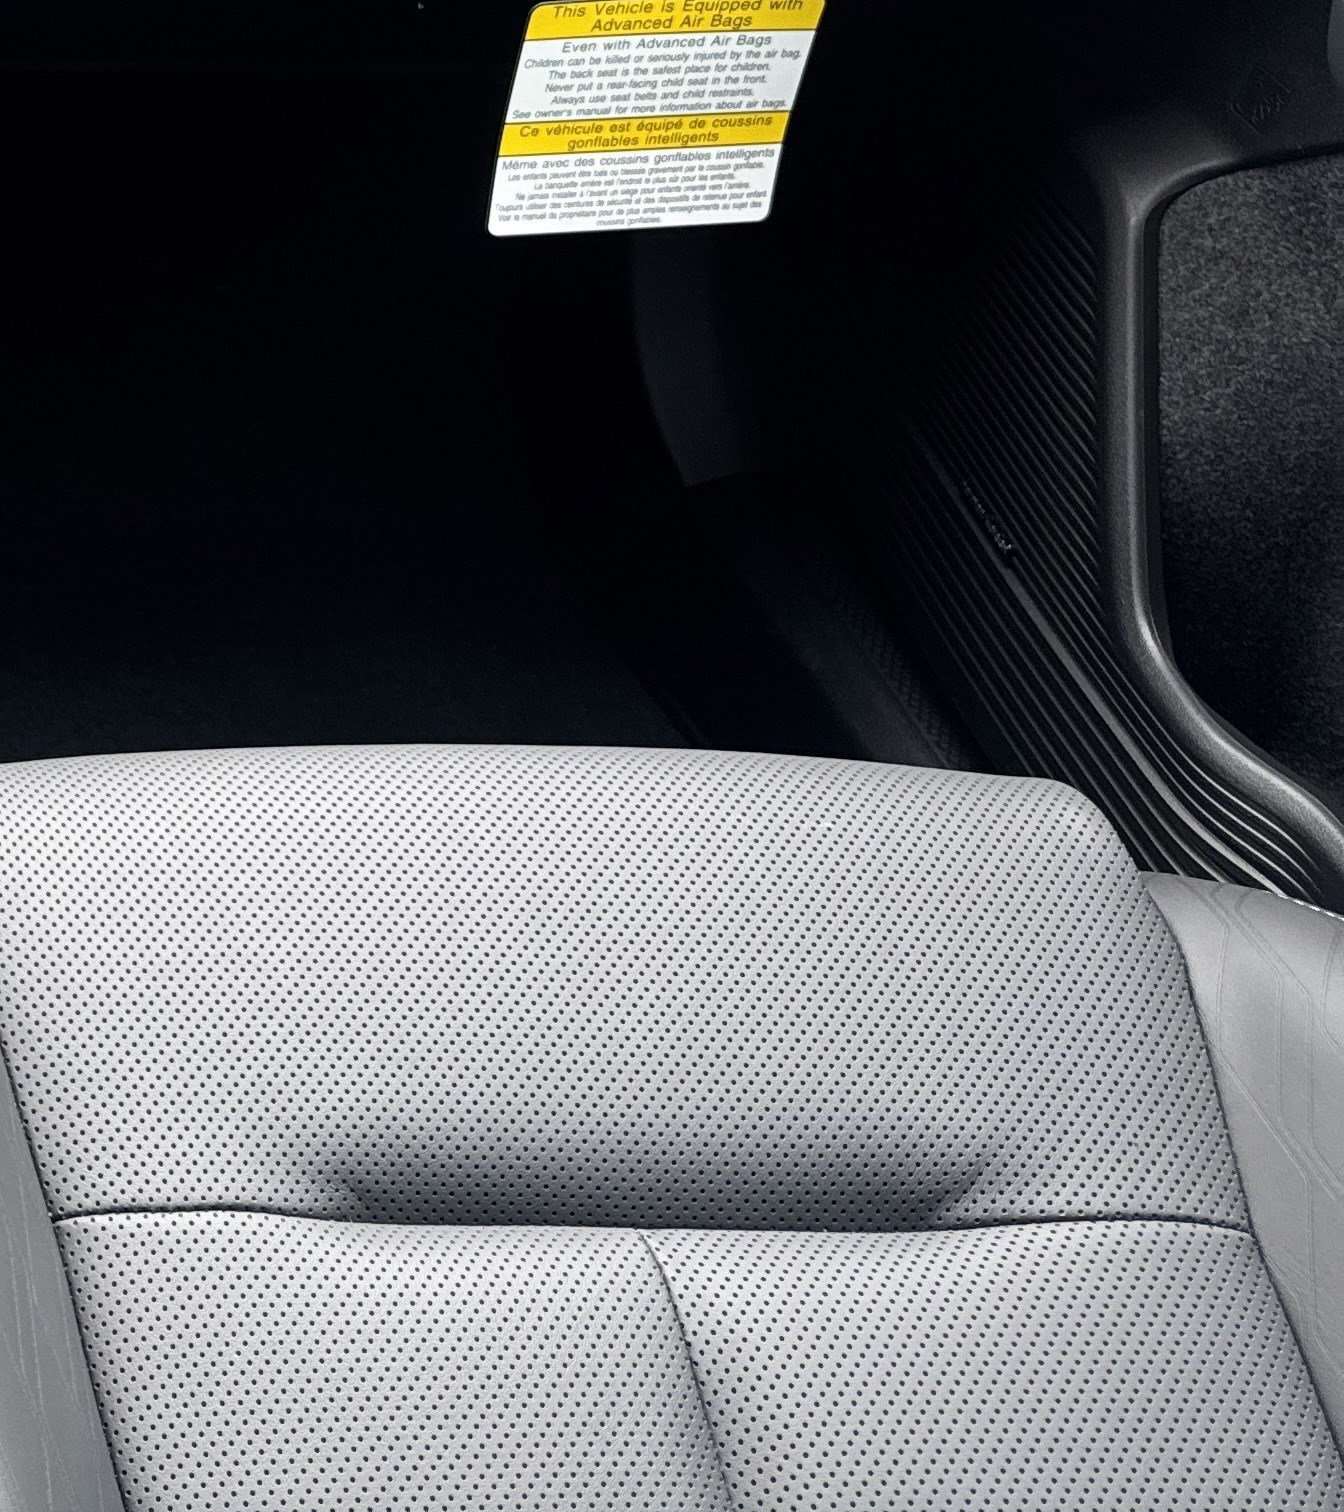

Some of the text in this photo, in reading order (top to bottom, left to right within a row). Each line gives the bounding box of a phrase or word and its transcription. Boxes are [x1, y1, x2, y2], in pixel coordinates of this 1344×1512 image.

[553, 5, 586, 18] This
[595, 2, 653, 16] Vehicle
[660, 0, 674, 13] is
[590, 14, 753, 32] Advanced Air Bags
[562, 34, 772, 53] Even with Advanced Air Bags
[524, 59, 564, 69] Children
[567, 58, 585, 66] can
[520, 126, 539, 137] Ce
[609, 122, 631, 133] est
[689, 118, 706, 128] de
[712, 115, 773, 128] coussins
[567, 132, 719, 151] gonflables intelligents
[542, 159, 569, 169] avec
[574, 157, 595, 167] des
[600, 154, 649, 165] coussins
